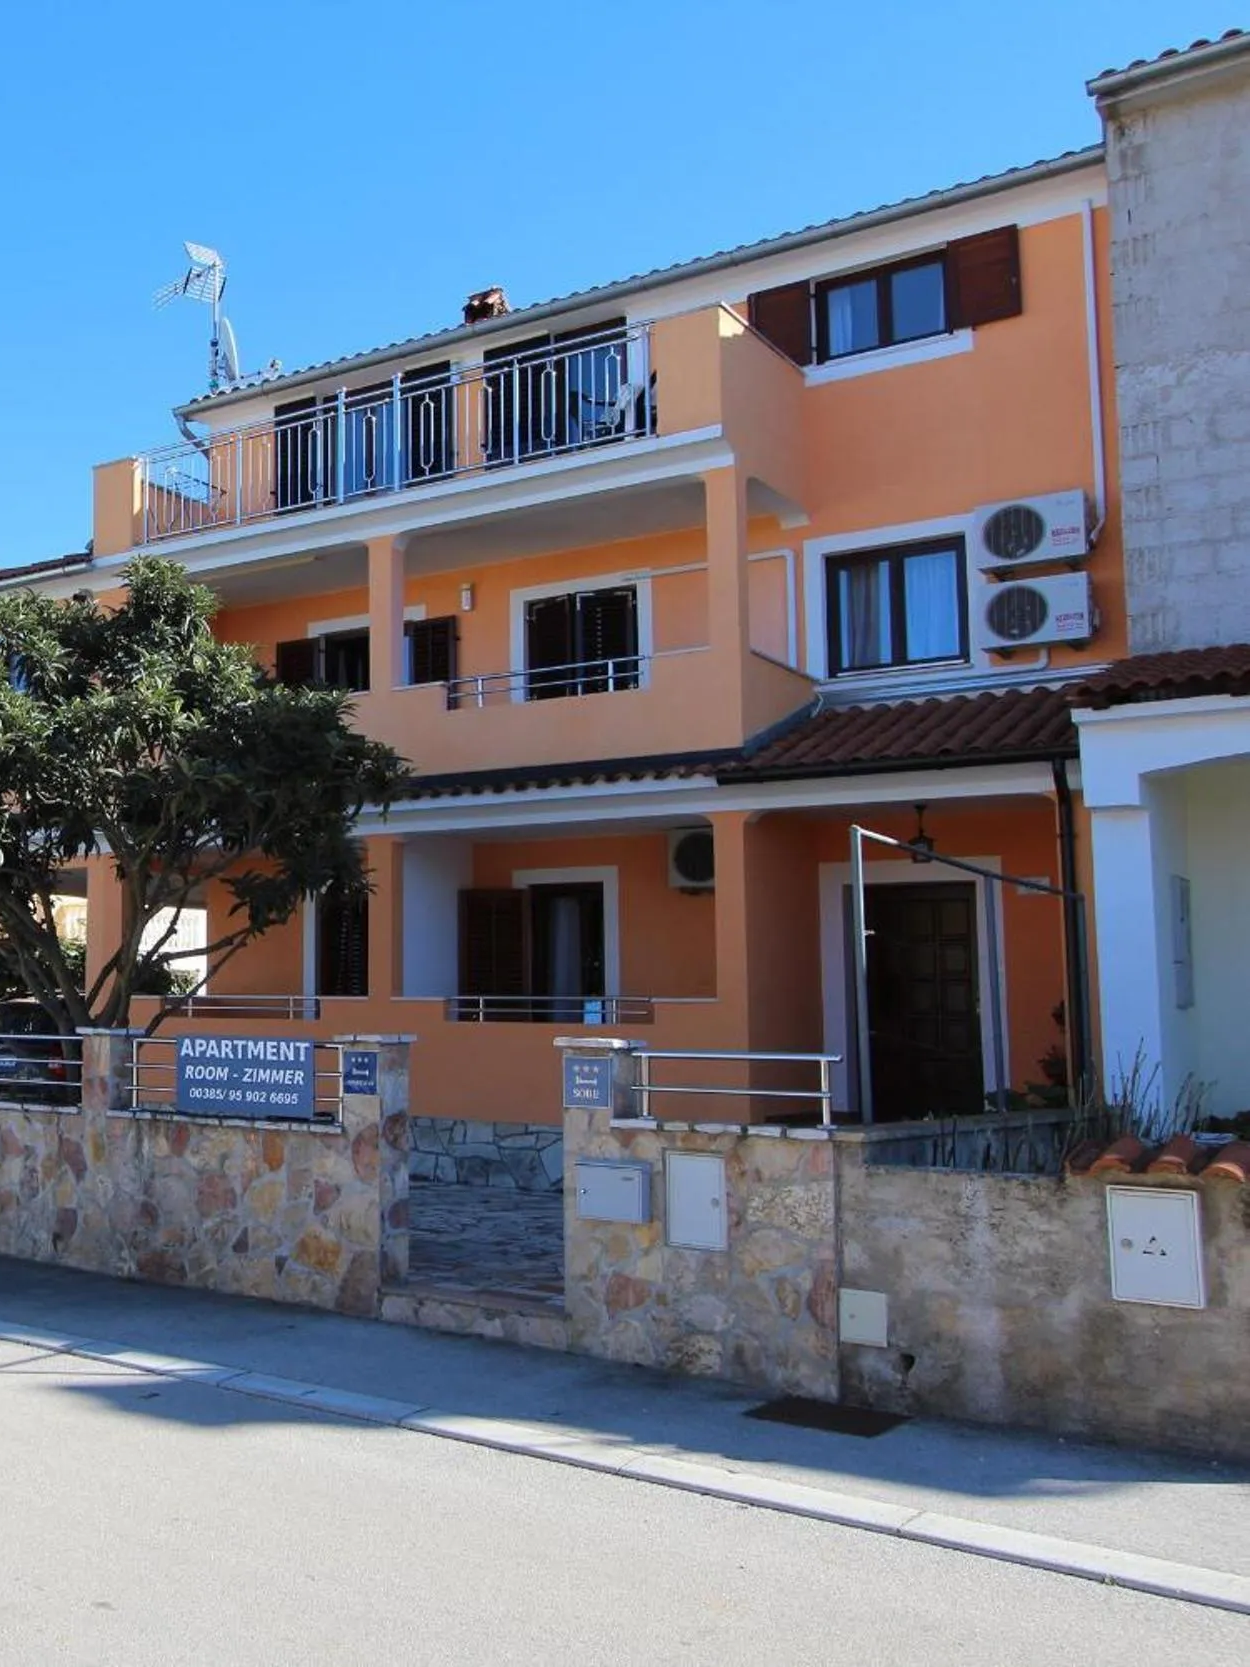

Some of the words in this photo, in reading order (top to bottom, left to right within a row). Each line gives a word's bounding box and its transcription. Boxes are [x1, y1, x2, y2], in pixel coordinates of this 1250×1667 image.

[180, 1038, 310, 1062] APARTMENT
[184, 1065, 229, 1081] ROOM
[241, 1067, 305, 1085] ZIMMER
[229, 1089, 242, 1101] 95
[245, 1091, 267, 1103] 902
